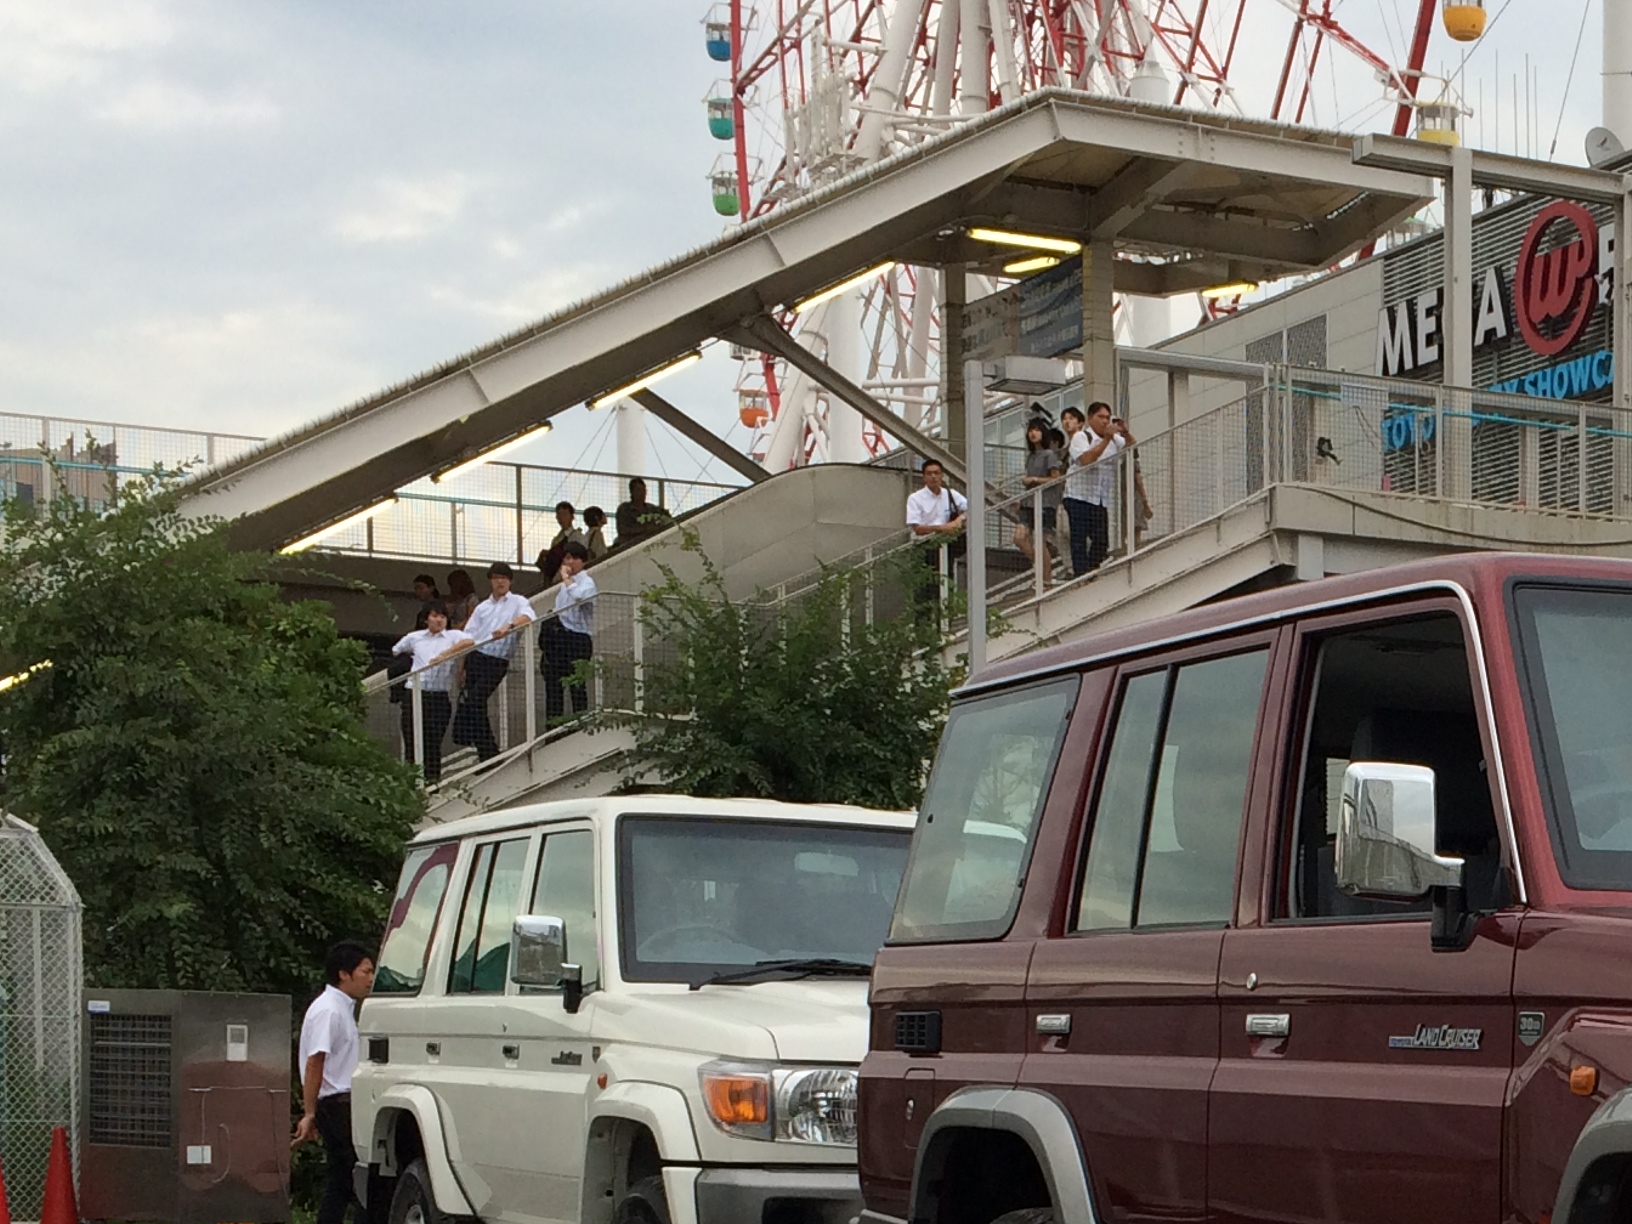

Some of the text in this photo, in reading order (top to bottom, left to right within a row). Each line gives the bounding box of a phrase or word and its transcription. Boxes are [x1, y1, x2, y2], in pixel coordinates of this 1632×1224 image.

[1376, 265, 1507, 377] MEA
[1412, 1023, 1482, 1050] LAND CRUISER
